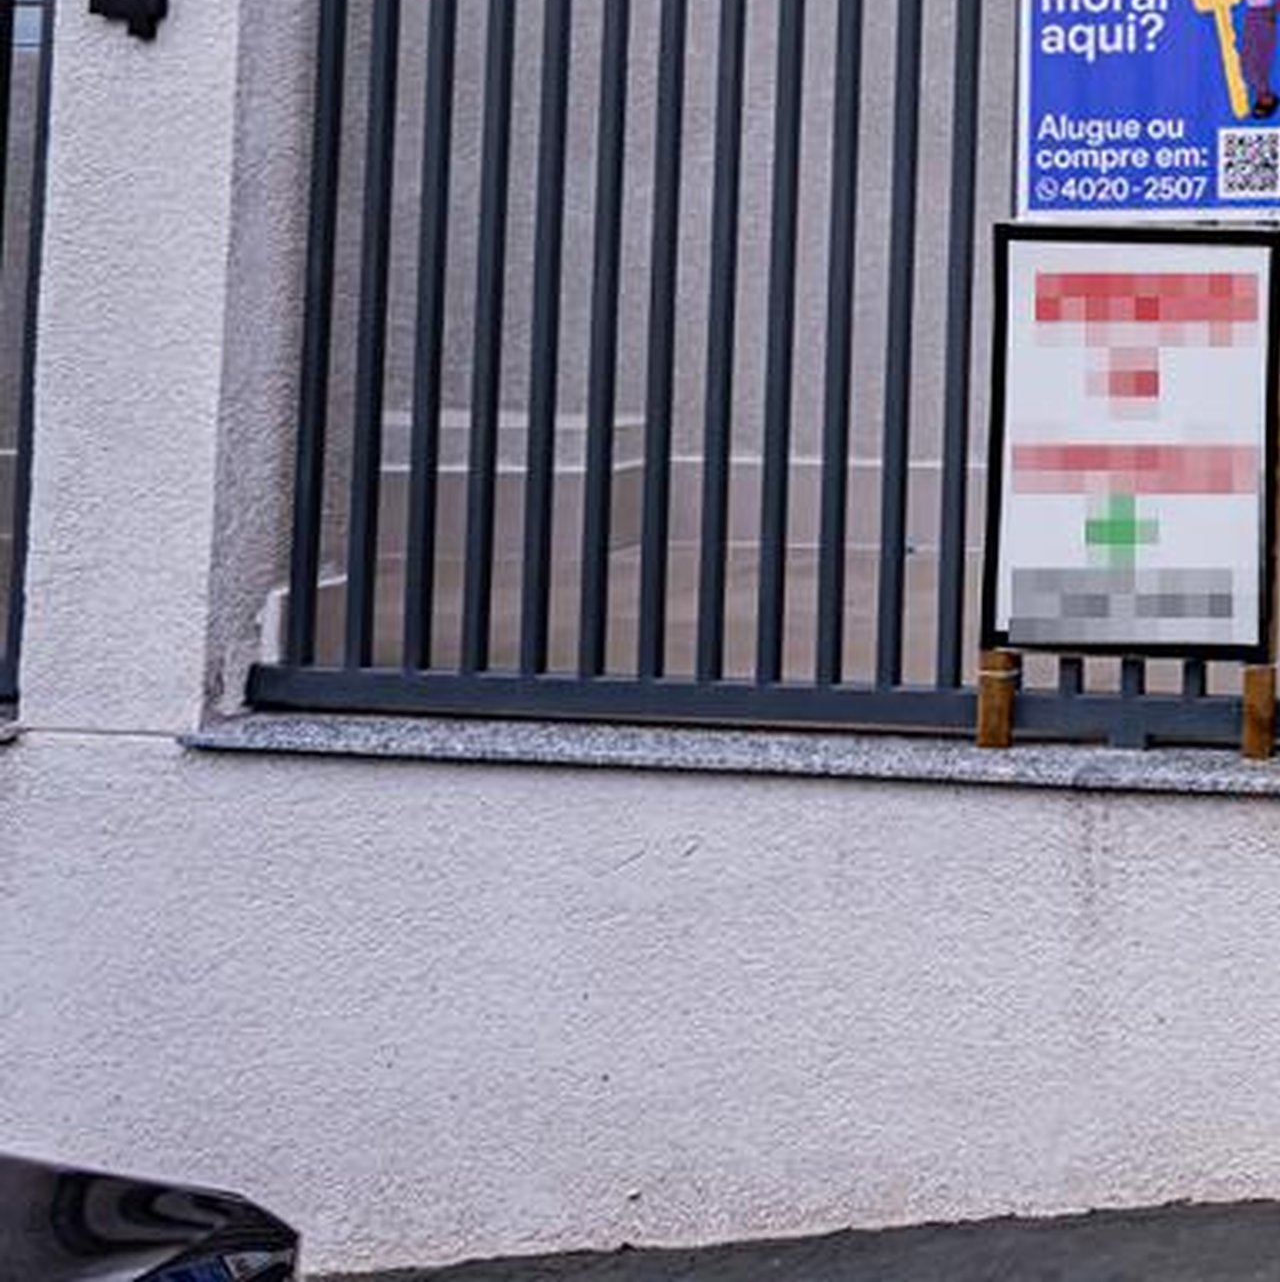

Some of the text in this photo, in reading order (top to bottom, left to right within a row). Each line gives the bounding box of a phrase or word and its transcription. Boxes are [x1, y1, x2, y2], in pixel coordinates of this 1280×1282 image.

[1041, 13, 1165, 62] aqui?
[1038, 115, 1184, 147] Alugue ou
[1036, 147, 1208, 174] compre em:
